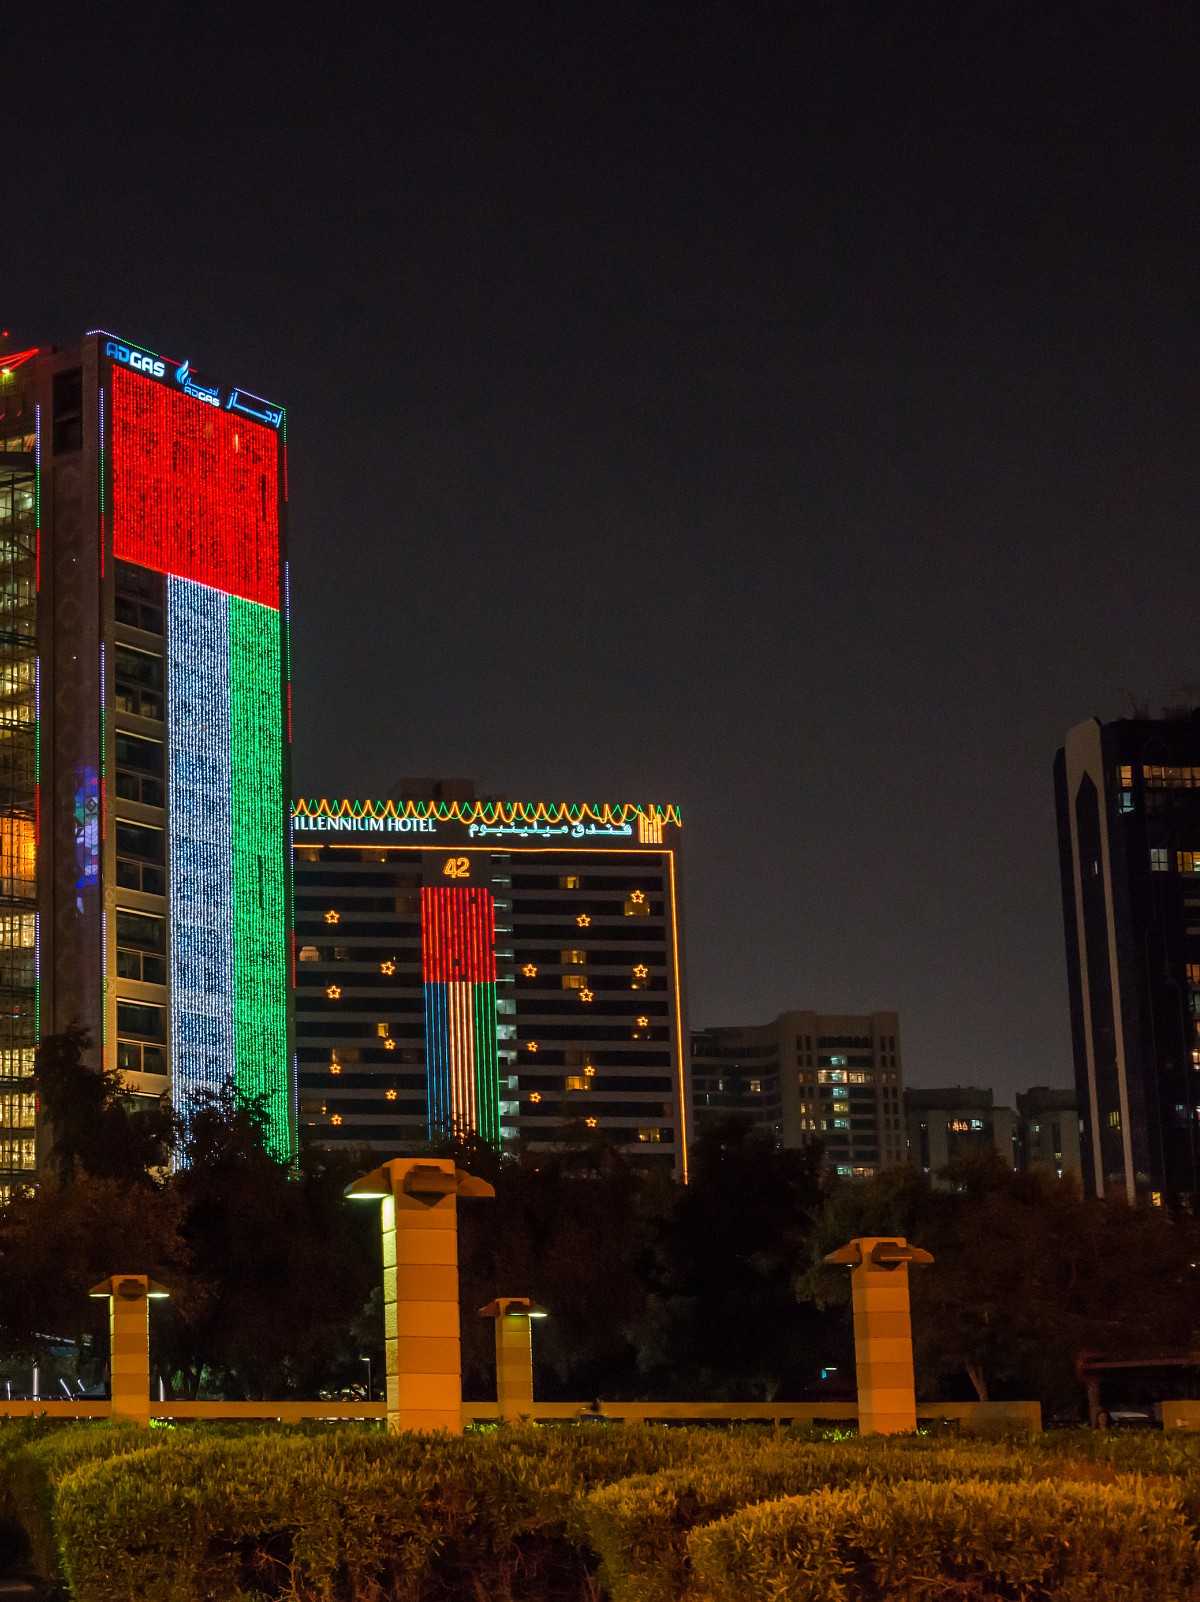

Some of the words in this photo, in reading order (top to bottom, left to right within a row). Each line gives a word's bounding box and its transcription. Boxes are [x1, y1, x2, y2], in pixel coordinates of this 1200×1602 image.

[106, 341, 166, 377] ADGAS
[184, 386, 220, 407] ADGAS
[387, 818, 437, 832] HOTEL
[571, 821, 633, 838] فندق
[443, 857, 471, 879] 42
